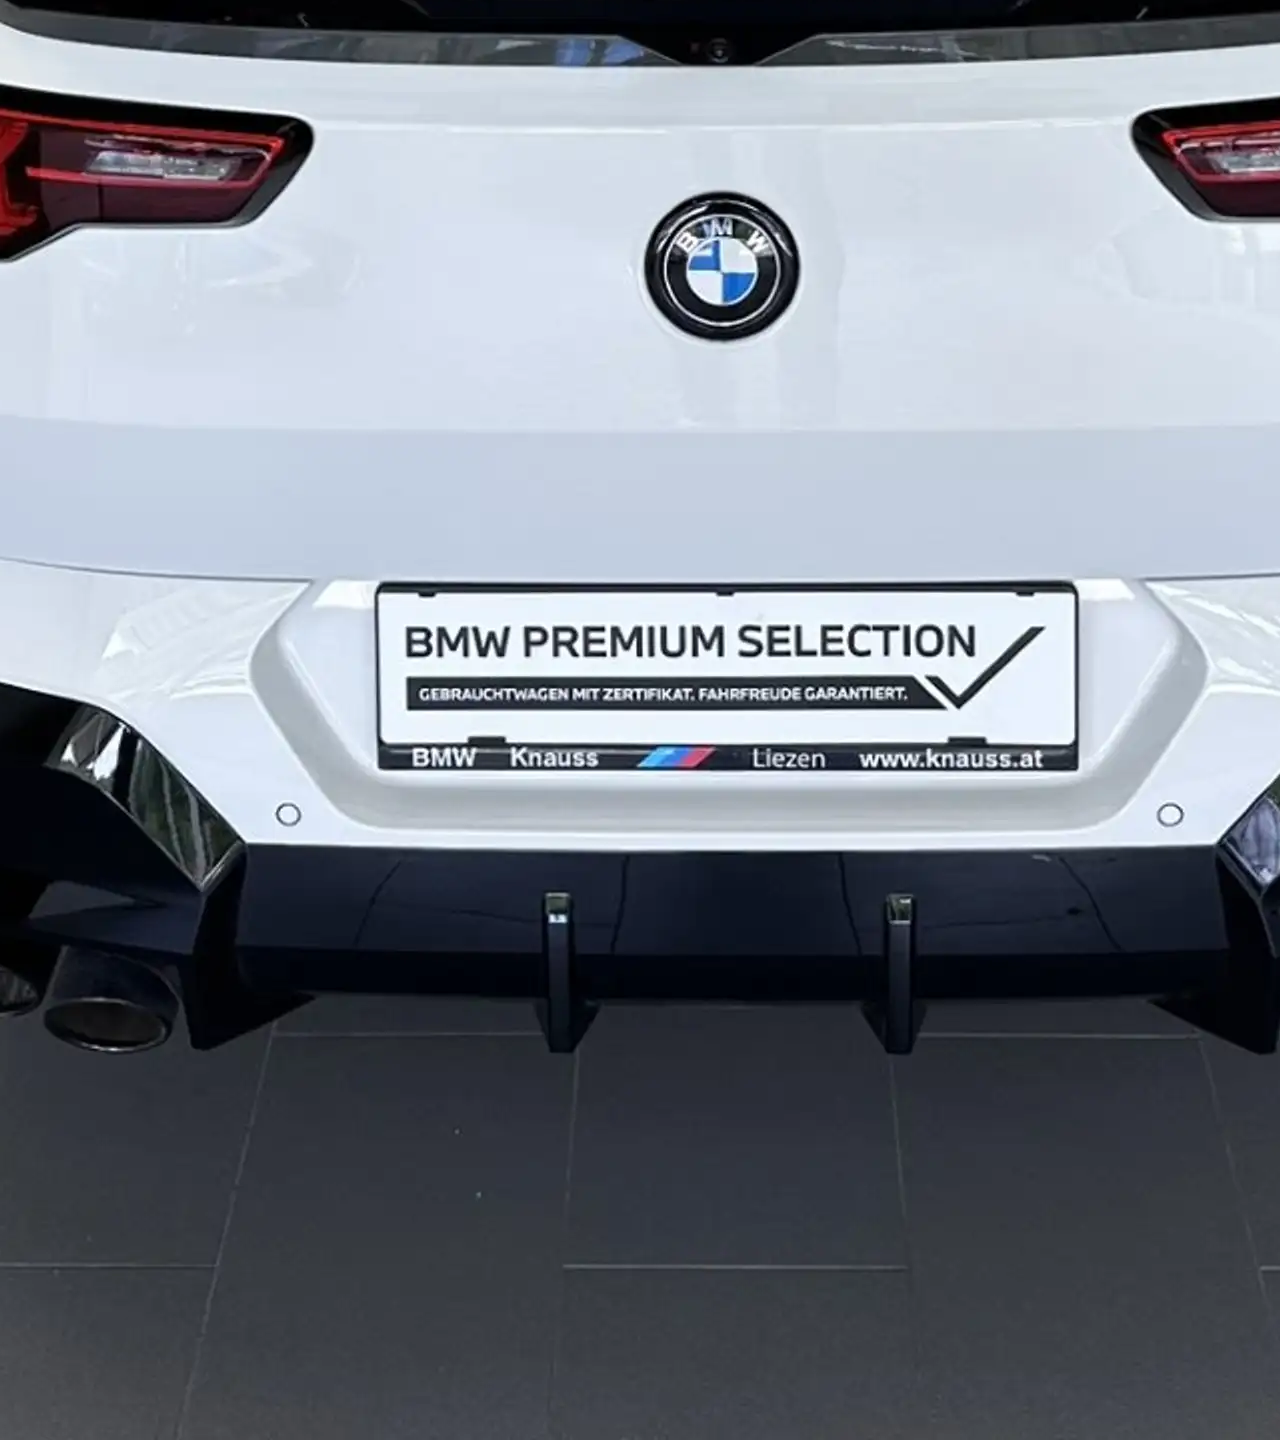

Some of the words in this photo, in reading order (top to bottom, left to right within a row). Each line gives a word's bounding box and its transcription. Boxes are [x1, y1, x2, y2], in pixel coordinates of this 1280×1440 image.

[676, 217, 770, 253] BMW
[405, 626, 511, 658] BMW
[524, 625, 725, 658] PREMIUM
[738, 624, 976, 657] SELECTION
[419, 687, 570, 702] GEBRAUCHTWAGEN
[572, 687, 602, 702] MIT
[603, 687, 696, 702] ZERTIFIKAT.
[699, 686, 801, 702] FAHRFREUDE
[804, 686, 908, 702] GARANTIERT.
[412, 747, 478, 768] BMW
[511, 747, 599, 768] Knauss
[753, 748, 826, 769] Liezen
[859, 747, 1044, 769] www.knauss.at
